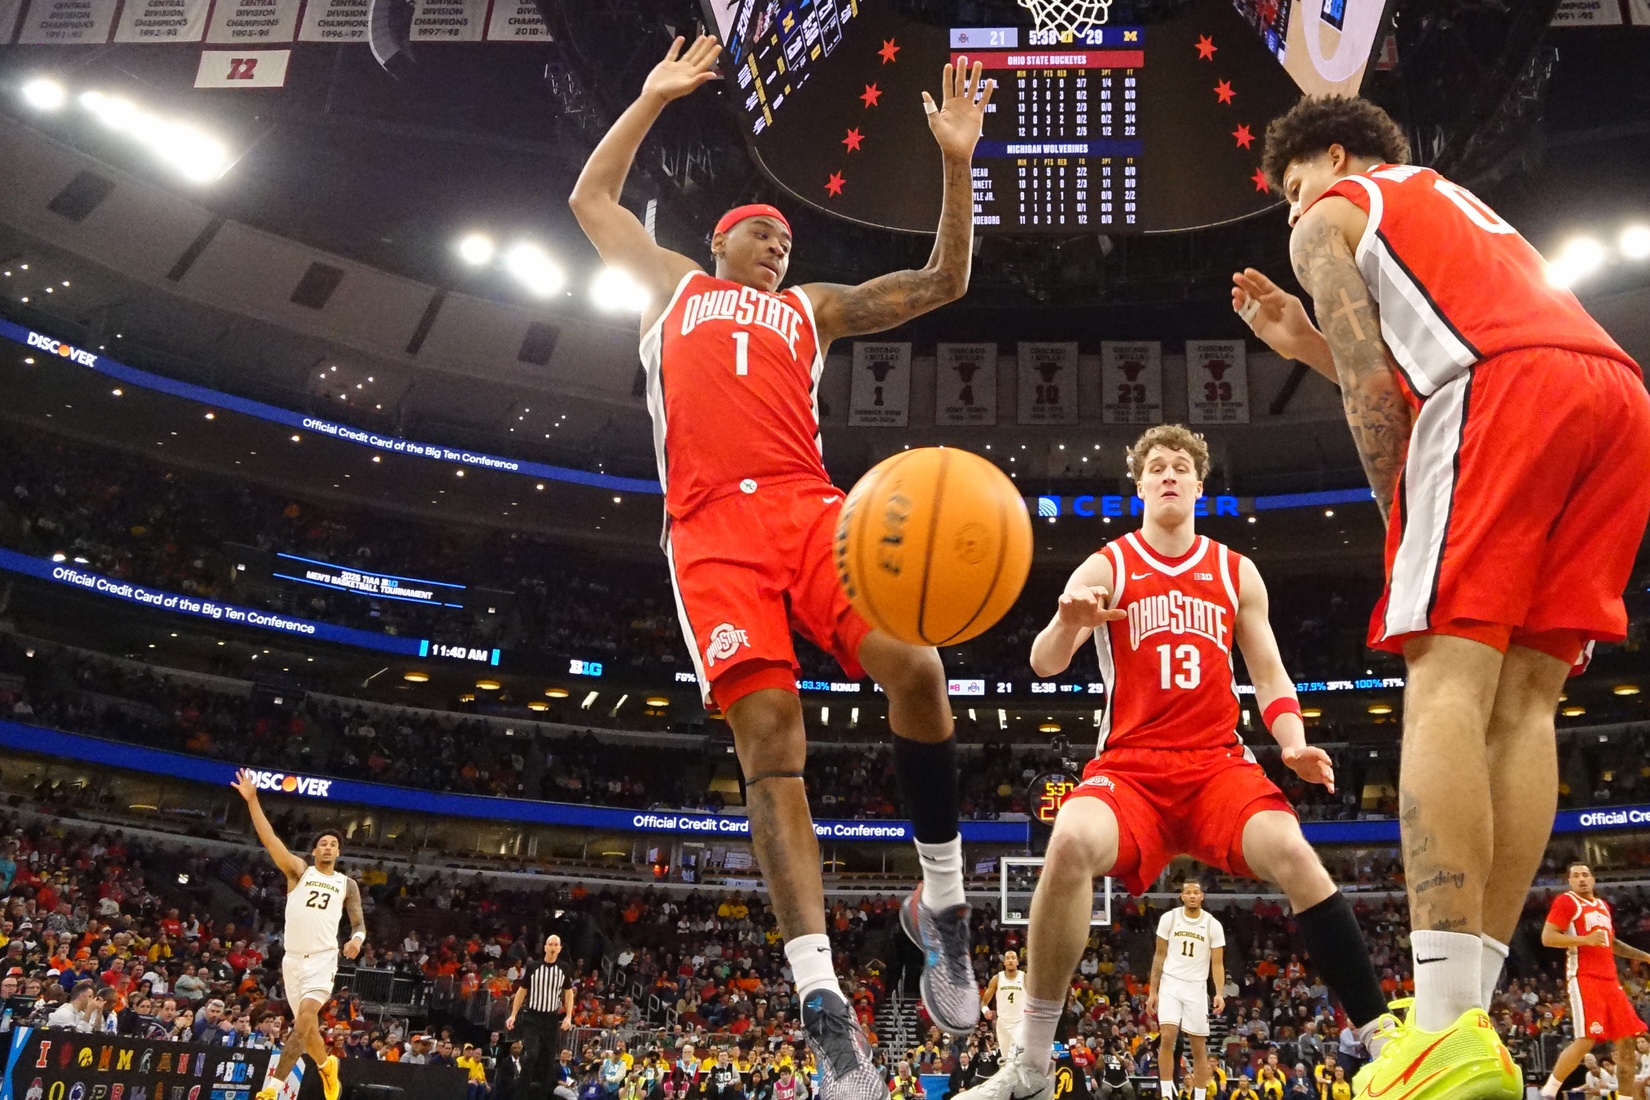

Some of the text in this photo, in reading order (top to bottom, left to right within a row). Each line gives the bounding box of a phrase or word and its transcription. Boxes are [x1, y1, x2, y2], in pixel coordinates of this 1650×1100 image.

[40, 20, 94, 29] CHAMPIONS
[134, 18, 188, 26] CHAMPIONS
[990, 30, 1005, 46] 21
[1086, 29, 1103, 44] 29
[1008, 54, 1087, 66] OHIO STATE BUCKEYES
[226, 58, 258, 80] 72
[1017, 77, 1136, 89] 10 3/7 1/4 0/0
[1018, 89, 1136, 101] 11 0/2 0/1 0/0
[1017, 101, 1136, 113] 13 2/3 0/0 0/0
[1018, 113, 1136, 125] 11 0/2 0/2 3/4
[1018, 125, 1136, 137] 12 2/5 1/2 2/2
[1006, 144, 1088, 154] MICHIGAN WOLVERINES
[1018, 166, 1136, 177] 13 2/2 1/1 0/0
[1018, 178, 1136, 189] 10 2/3 1/1 0/0
[984, 190, 1136, 201] JR. 9 0/1 0/0 2/2
[1020, 202, 1136, 213] 8 0/1 0/0 0/0
[1019, 214, 1136, 225] 11 1/2 0/0 1/2
[27, 332, 95, 368] DISCOVER
[732, 332, 749, 376] 1
[874, 386, 884, 406] 1
[958, 384, 974, 406] 4
[1036, 384, 1060, 404] 10
[1118, 384, 1146, 404] 23
[1204, 382, 1232, 401] 33
[302, 418, 337, 435] Official
[338, 427, 368, 443] Credit
[369, 436, 393, 448] Card
[407, 443, 423, 454] the
[425, 446, 441, 459] Big
[444, 450, 460, 461] Ten
[462, 454, 518, 470] Conference
[1073, 495, 1239, 517] CENER
[341, 571, 380, 586] 2026 TIAA
[306, 571, 433, 600] MEN'S BASKETBALL TOURNAMENT
[53, 567, 315, 634] Official Credit Card of the Big Ten Conference
[432, 644, 488, 661] 11:40 AM
[1156, 644, 1200, 689] 13
[675, 672, 696, 683] FG%
[802, 680, 860, 692] 83.3% BONUS
[950, 684, 960, 692] #8
[996, 682, 1012, 693] 21
[1031, 682, 1056, 693] 5:38
[1088, 683, 1104, 694] 29
[1297, 678, 1404, 692] 57.9% 3PT% 100% FT%
[1046, 783, 1074, 796] 5:37
[633, 816, 749, 832] Official Credit Card
[1580, 810, 1650, 826] Official Cre
[834, 824, 904, 836] Conference
[305, 881, 339, 894] MICHIGAN
[306, 890, 331, 910] 23
[1174, 932, 1205, 942] MICHIGAN
[1182, 940, 1194, 957] 11
[1008, 992, 1014, 1003] 4
